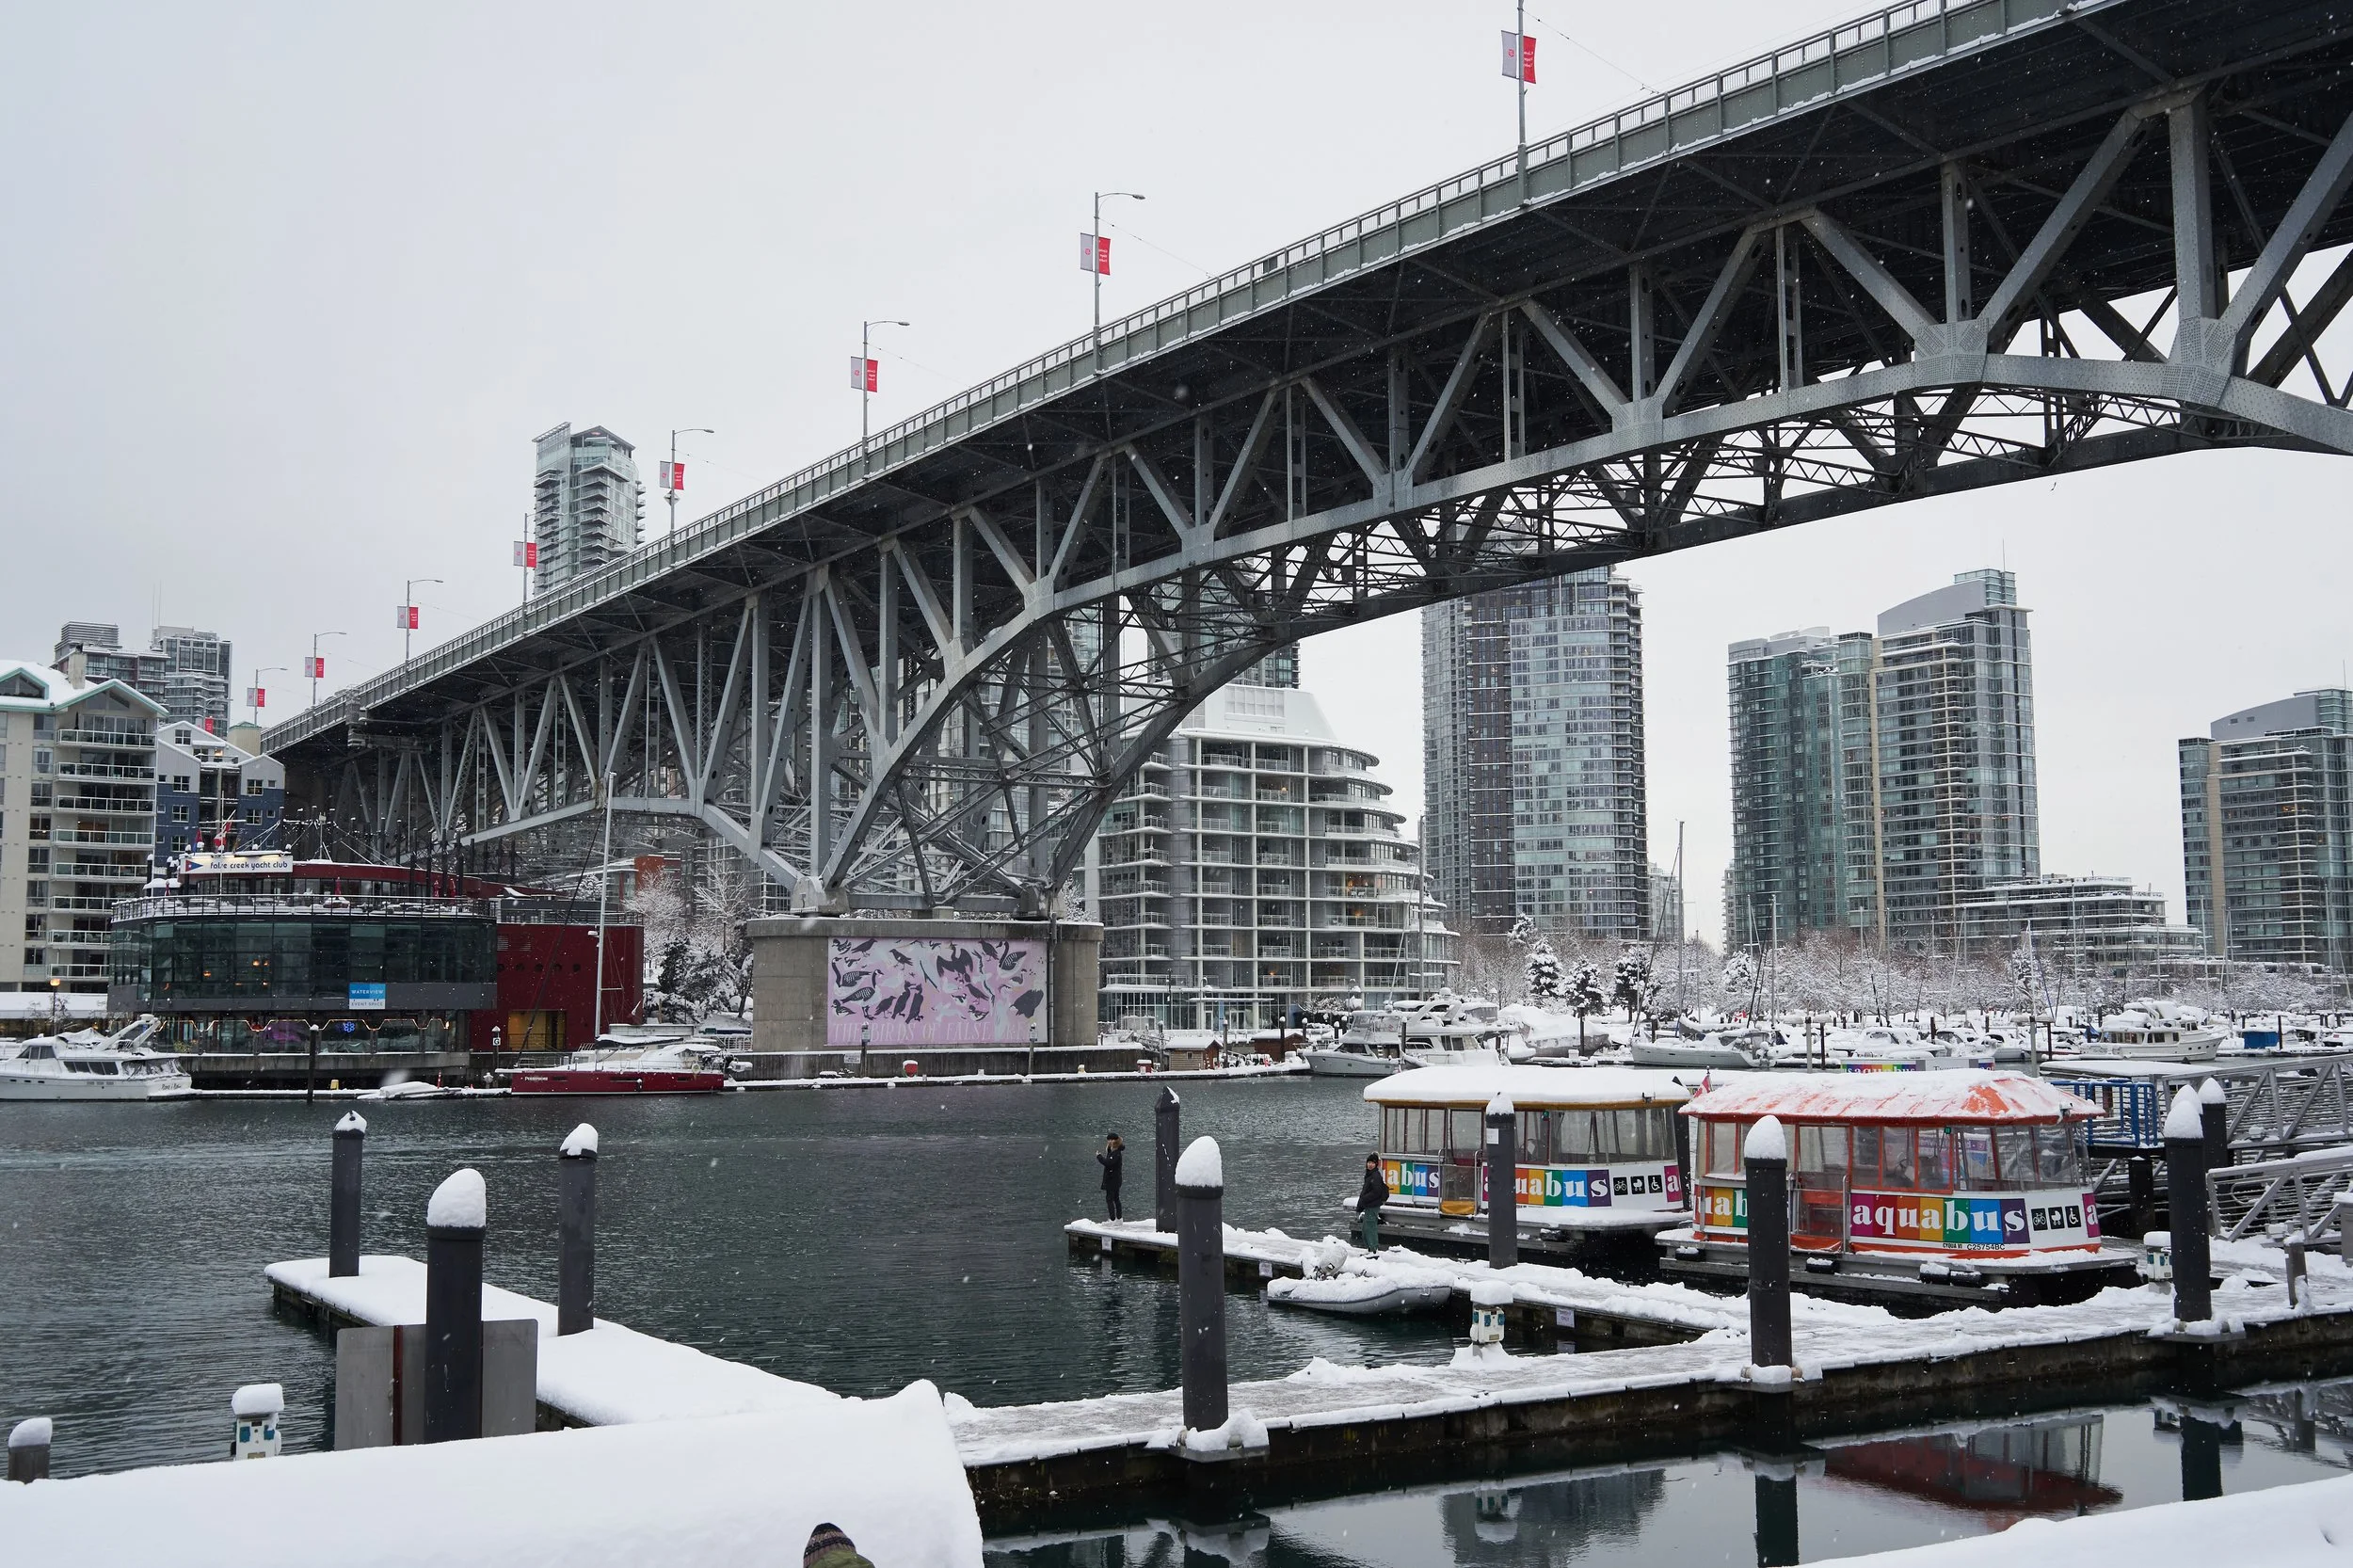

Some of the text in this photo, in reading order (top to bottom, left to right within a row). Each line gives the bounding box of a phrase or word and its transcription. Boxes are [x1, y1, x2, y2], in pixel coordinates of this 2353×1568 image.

[230, 861, 249, 870] creek
[250, 860, 271, 871] yacht
[272, 859, 289, 869] club
[1852, 1200, 2025, 1236] aquabus
